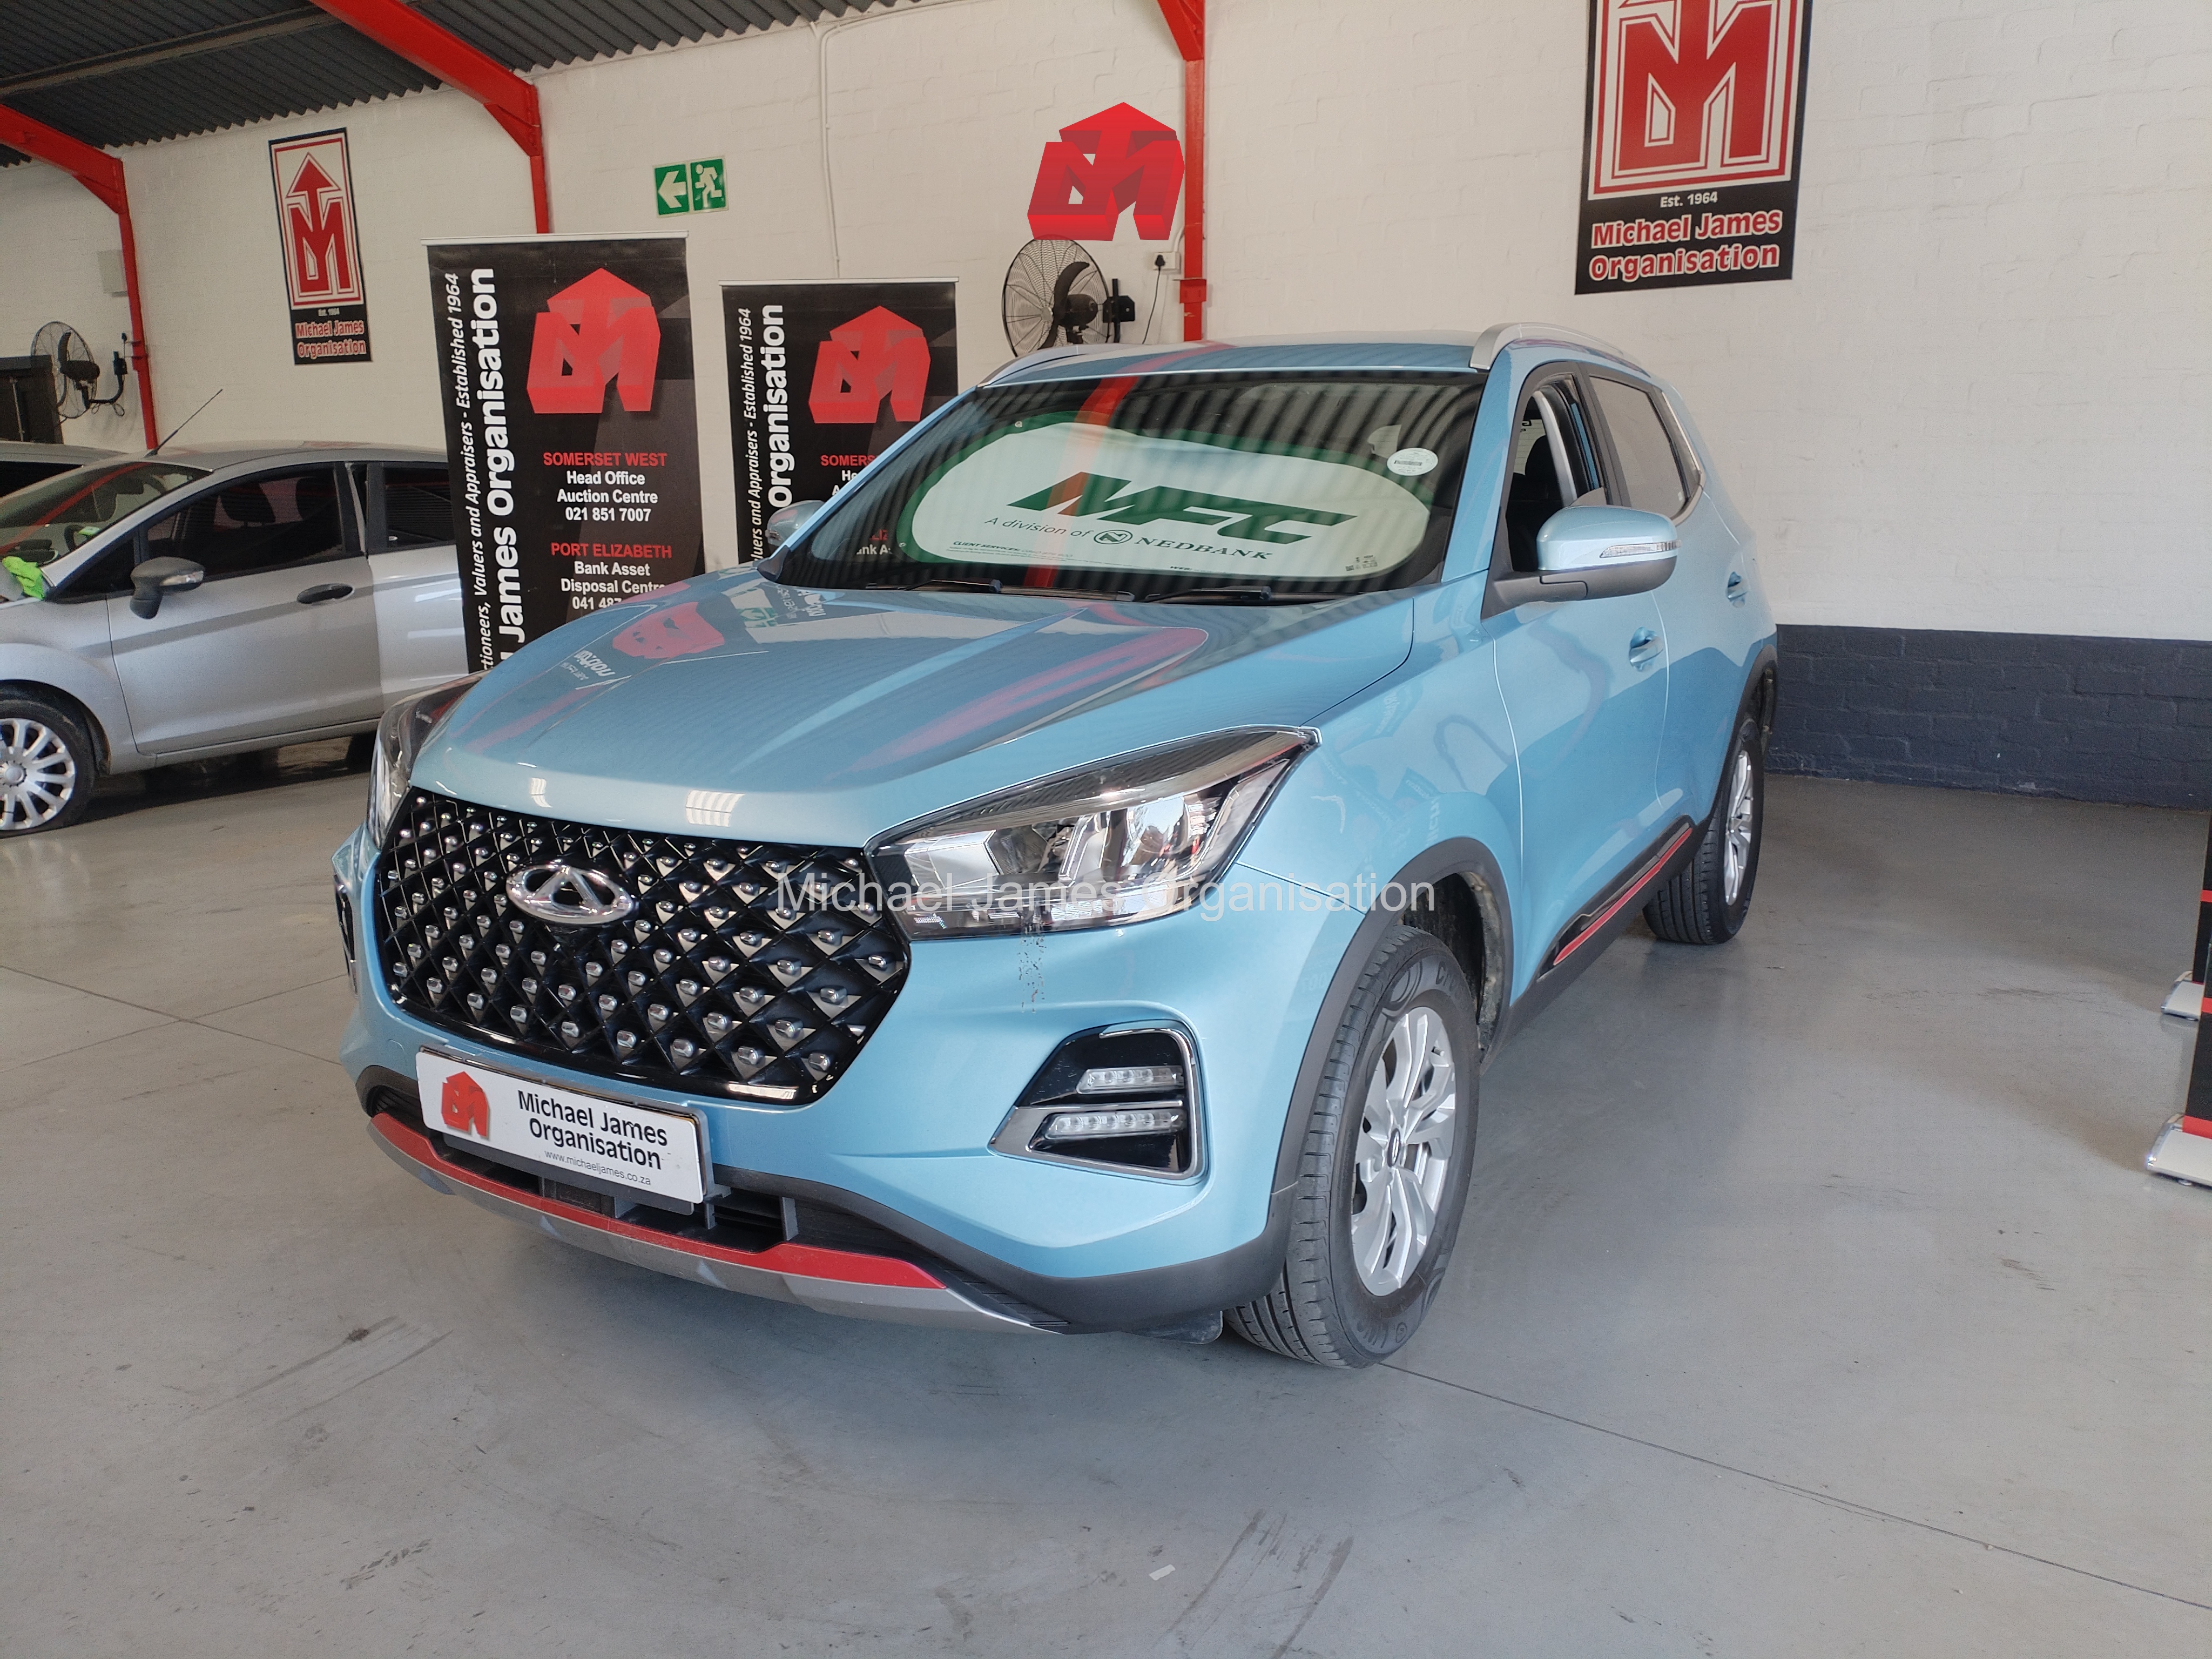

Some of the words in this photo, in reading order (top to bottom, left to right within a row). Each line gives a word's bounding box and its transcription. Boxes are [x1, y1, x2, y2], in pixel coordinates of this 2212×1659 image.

[1661, 196, 1683, 208] Est.
[1688, 192, 1718, 206] 1964
[1591, 214, 1691, 249] Michael
[1695, 210, 1783, 239] James
[1589, 243, 1779, 282] Organisation
[444, 272, 460, 314] 1964
[295, 320, 333, 339] Michael
[333, 320, 365, 336] James
[738, 307, 751, 341] 1964
[297, 339, 367, 359] Organisation
[450, 318, 471, 409] Established
[471, 268, 515, 516] Organisation
[740, 343, 757, 420] Established
[761, 305, 795, 508] Organisation
[461, 421, 480, 504] Appraisers
[543, 452, 621, 467] SOMERSET
[625, 452, 667, 467] WEST
[744, 430, 763, 498] Appraisers
[820, 454, 875, 467] SOMERS
[566, 470, 601, 485] Head
[604, 470, 645, 485] Office
[557, 489, 609, 503] Auction
[612, 489, 658, 504] Centre
[747, 499, 762, 526] and
[1006, 471, 1357, 544] MFC
[465, 505, 482, 537] and
[565, 507, 588, 521] 021
[592, 507, 615, 521] 851
[621, 508, 651, 522] 7007
[984, 516, 999, 525] A
[1002, 520, 1067, 535] division
[1070, 529, 1094, 537] of
[551, 542, 588, 556] PORT
[593, 543, 672, 558] ELIZABETH
[750, 528, 764, 561] luers
[1134, 537, 1273, 559] NEDBANK
[471, 540, 487, 596] Valuers
[574, 561, 609, 575] Bank
[612, 562, 651, 576] Asset
[494, 527, 525, 643] James
[561, 578, 619, 595] Disposal
[572, 596, 595, 610] 041
[517, 1089, 594, 1129] Michael
[601, 1112, 667, 1146] James
[529, 1117, 662, 1170] Organisation
[544, 1150, 651, 1186] www.michaeljames.co.za
